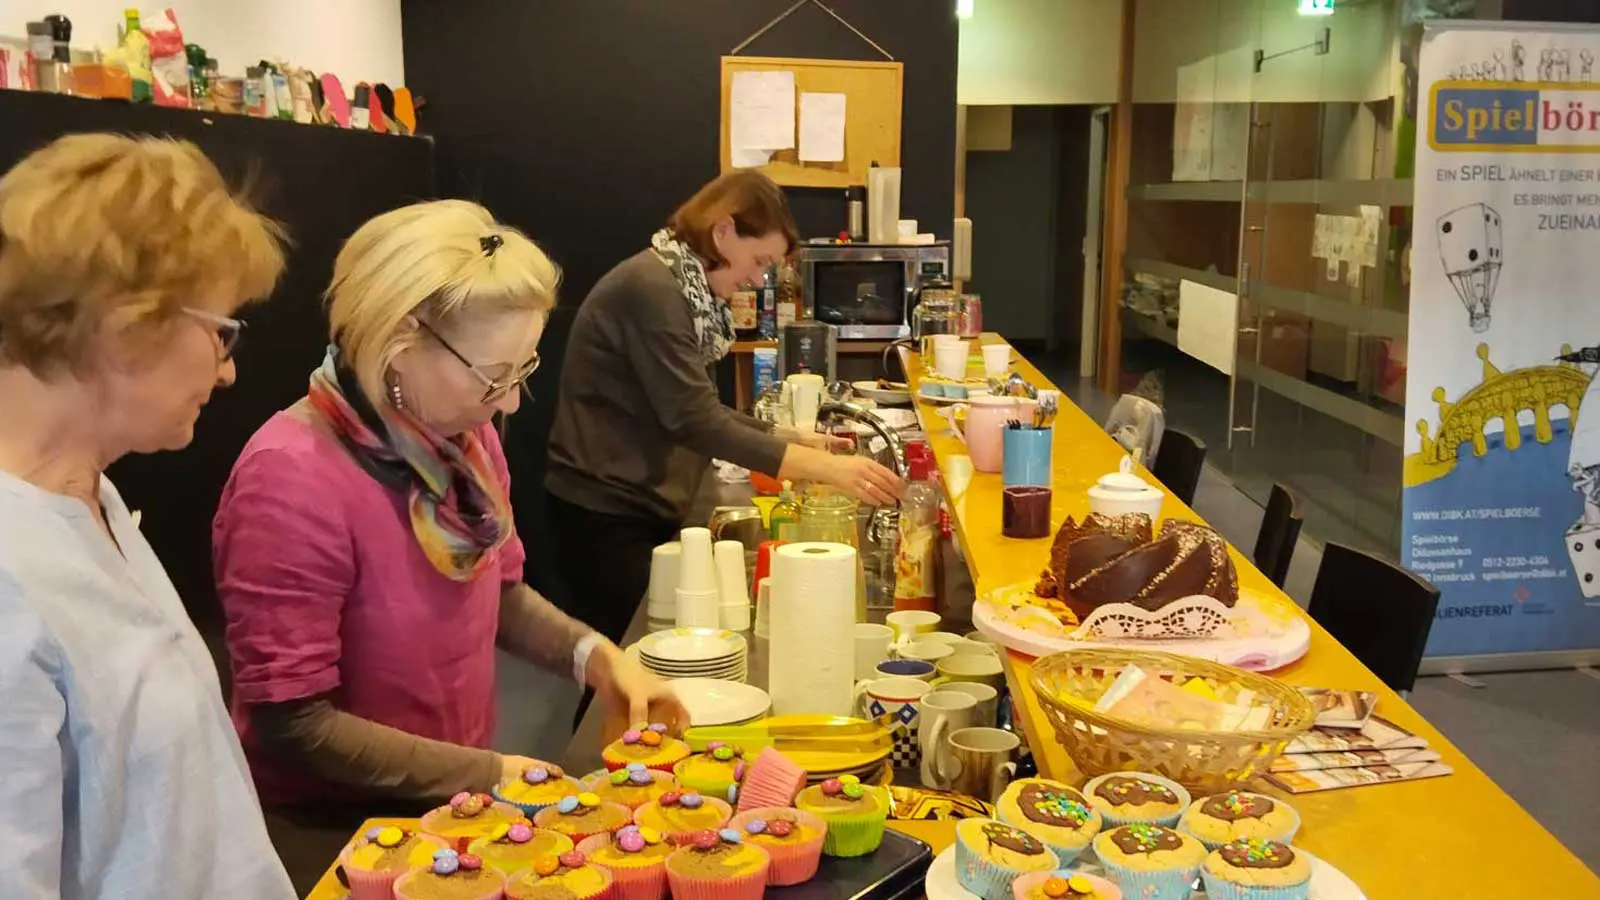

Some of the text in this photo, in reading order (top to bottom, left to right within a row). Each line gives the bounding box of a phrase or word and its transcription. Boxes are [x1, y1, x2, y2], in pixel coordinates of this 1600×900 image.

[1436, 169, 1456, 181] EIN
[1461, 165, 1505, 181] SPIEL
[1509, 166, 1556, 181] ÄHNELT
[1559, 169, 1594, 182] EINER
[1513, 193, 1529, 206] ES
[1531, 193, 1573, 206] BRINGT
[1538, 214, 1600, 230] ZUEINA
[1437, 604, 1513, 619] LIENREFERAT
